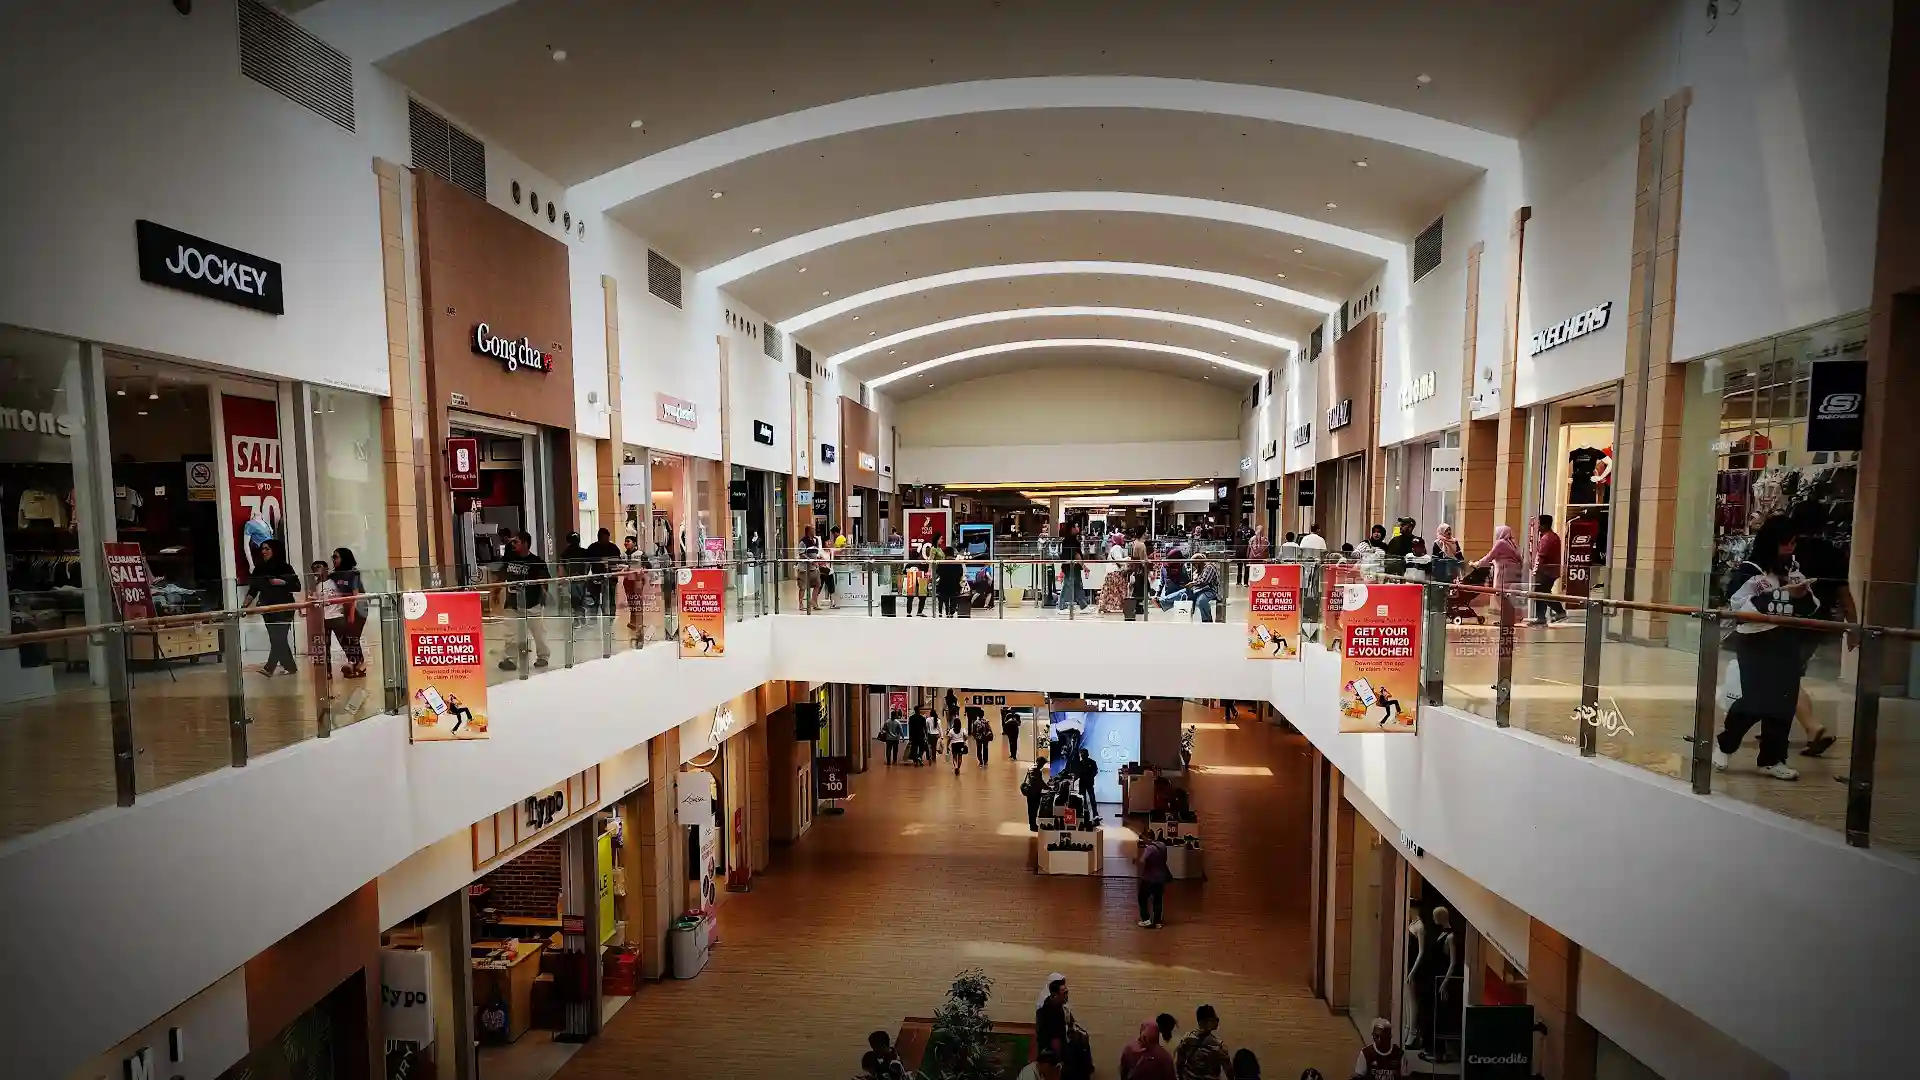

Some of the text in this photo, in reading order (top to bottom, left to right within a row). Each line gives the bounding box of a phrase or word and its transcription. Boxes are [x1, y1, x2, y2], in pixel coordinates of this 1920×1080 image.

[165, 245, 267, 296] JOCKEY
[1529, 301, 1612, 356] SKECHERS
[477, 323, 517, 370] Gong
[519, 337, 542, 369] cha
[1569, 554, 1590, 563] SALE
[110, 566, 146, 583] SALE
[1355, 627, 1408, 636] GET YOUR
[419, 634, 471, 645] GET YOUR
[1352, 637, 1410, 646] FREE RM20
[418, 644, 474, 655] FREE RM20
[1348, 647, 1413, 657] E-VOUCHER!
[415, 654, 479, 665] E-VOUCHER!
[1098, 699, 1142, 711] FLEXX
[829, 773, 836, 782] 8
[826, 782, 843, 791] 100
[525, 790, 564, 829] Typo
[1467, 1052, 1528, 1064] Crocodile
